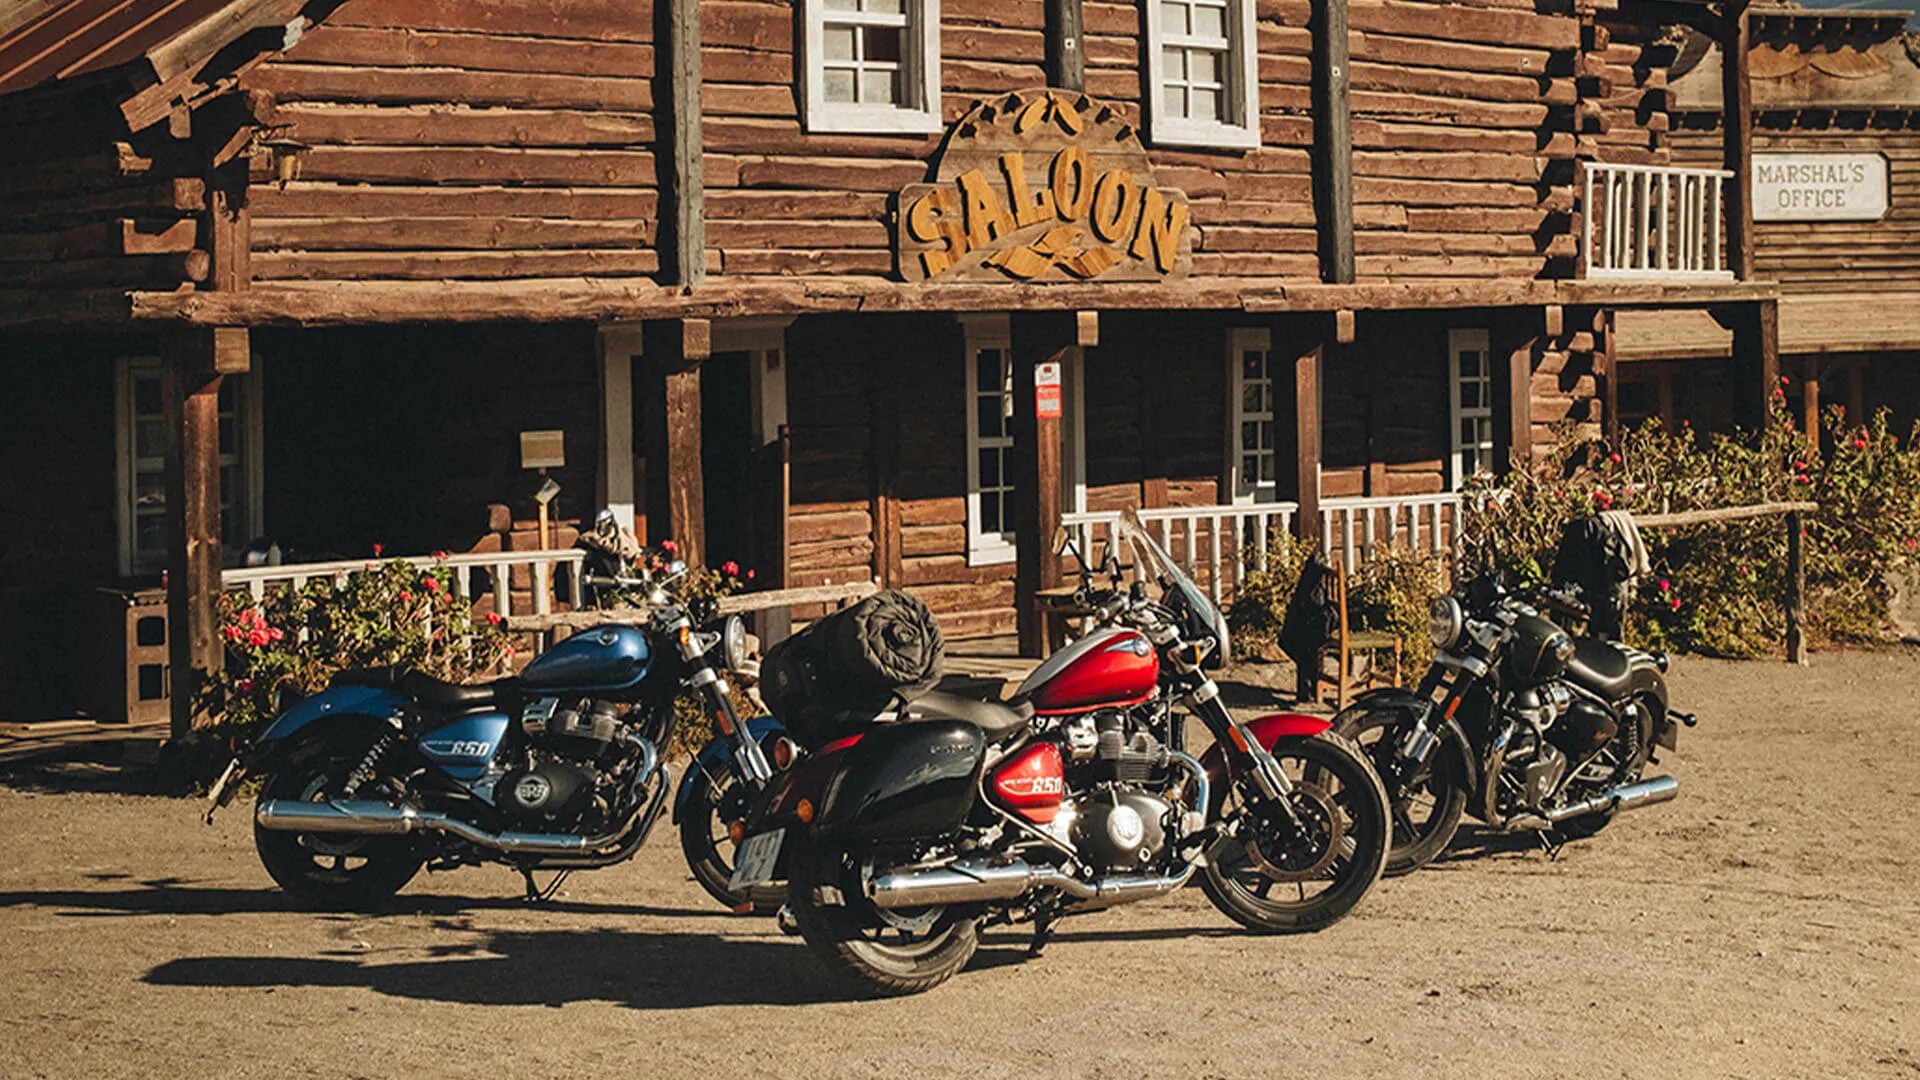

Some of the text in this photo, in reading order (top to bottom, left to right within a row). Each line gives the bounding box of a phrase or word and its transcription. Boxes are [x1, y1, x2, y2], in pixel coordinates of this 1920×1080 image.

[1757, 163, 1865, 184] MARSHAL'S
[1778, 188, 1845, 208] OFFICE
[905, 145, 1187, 279] SALOON
